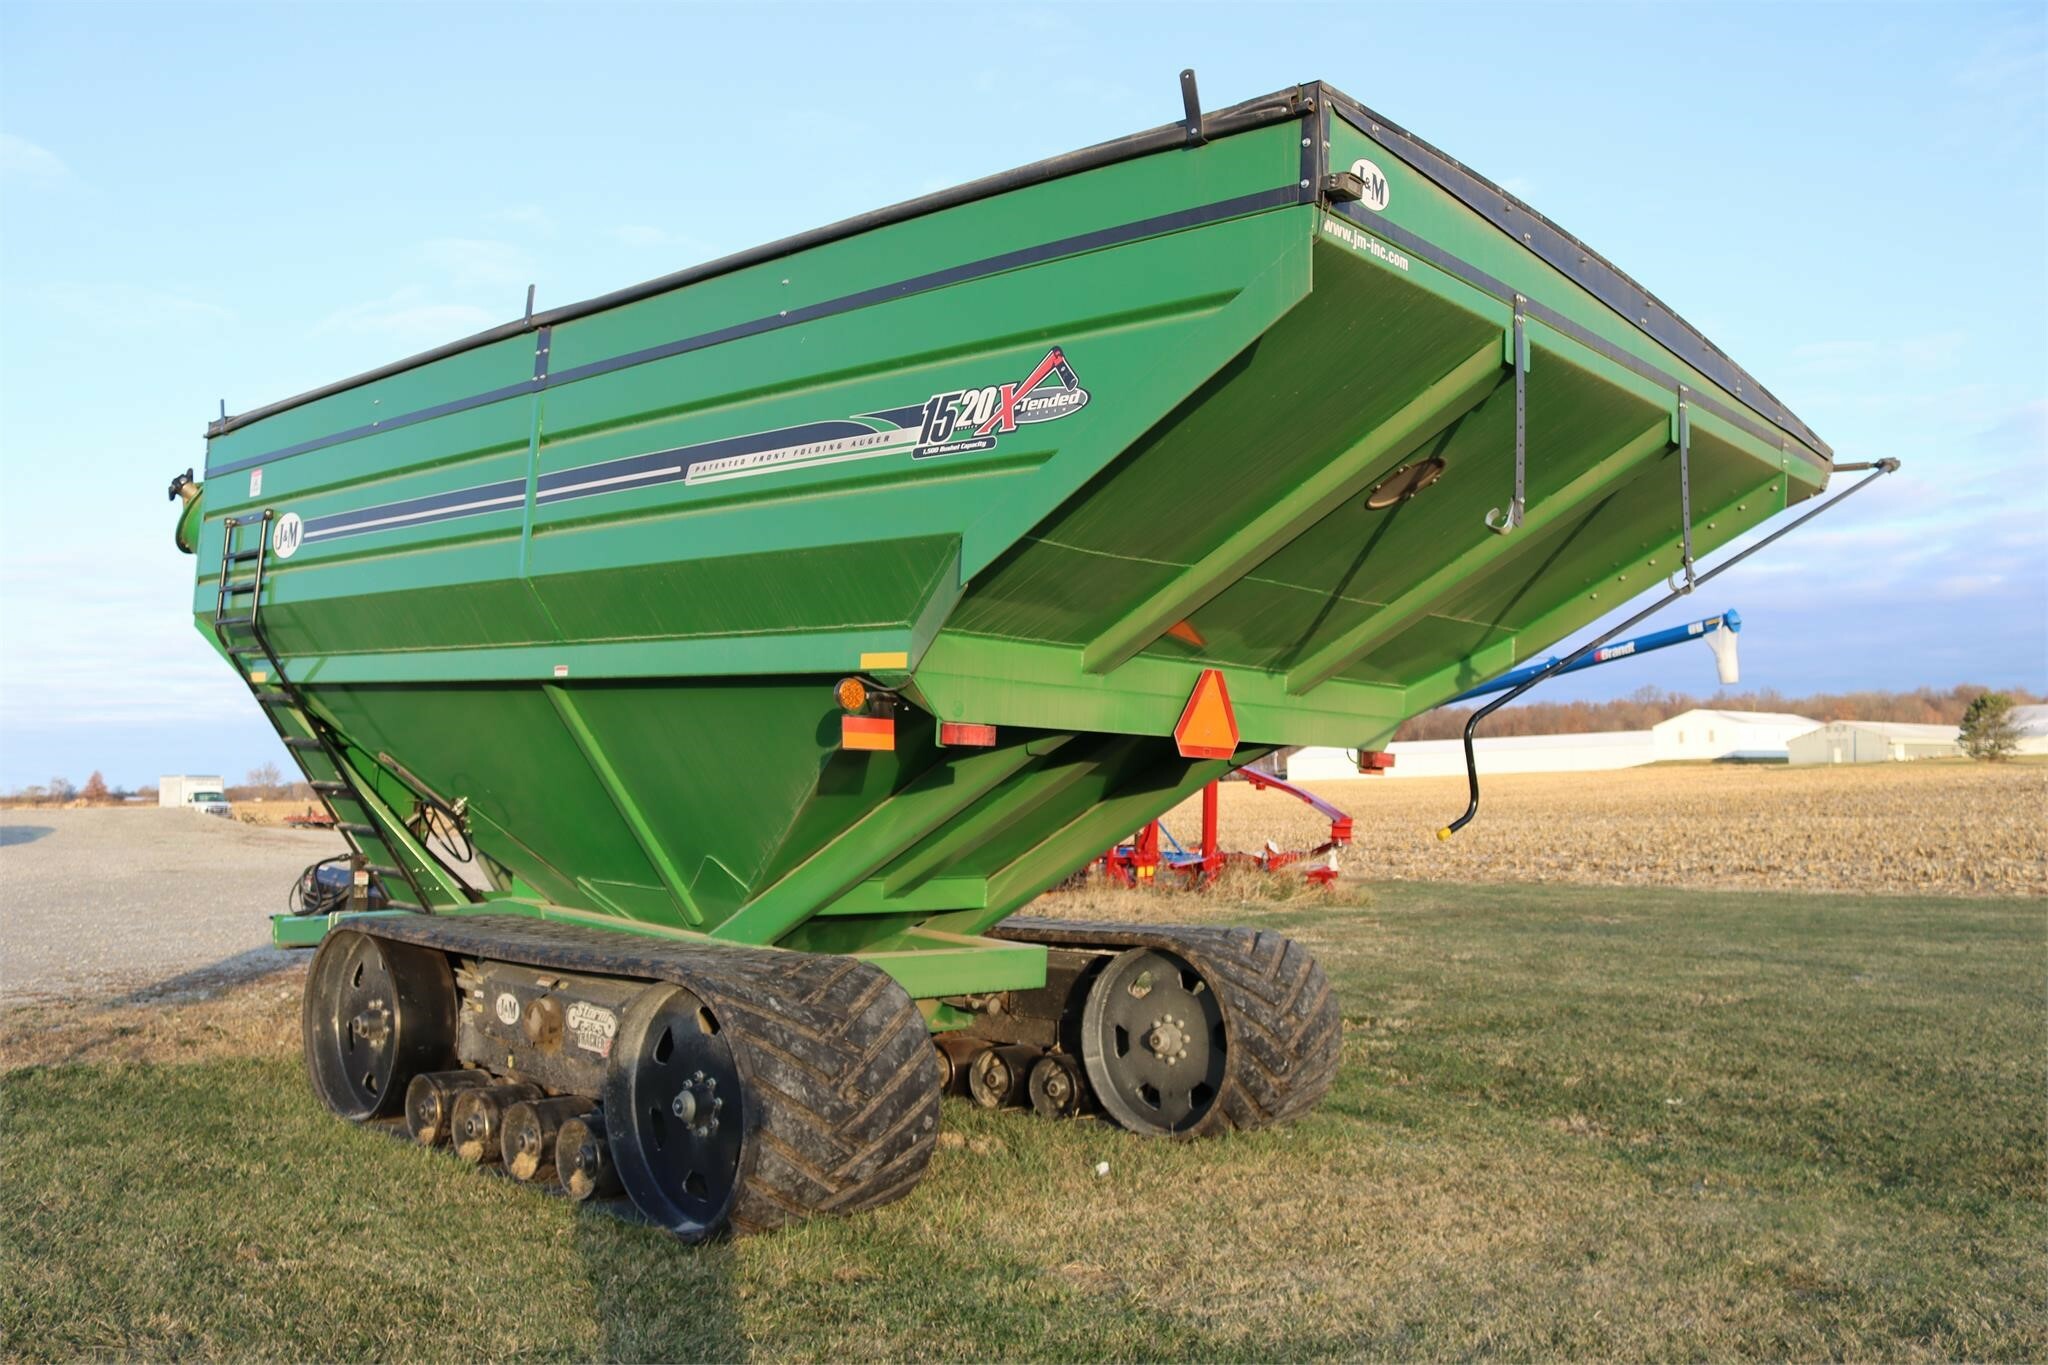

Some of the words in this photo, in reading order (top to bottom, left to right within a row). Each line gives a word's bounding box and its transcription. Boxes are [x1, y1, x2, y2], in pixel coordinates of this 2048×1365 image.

[1324, 219, 1409, 272] www.jm-inc.com
[917, 386, 997, 446] 1520
[974, 372, 1081, 437] X-Tended
[694, 457, 746, 472] PATENTED
[752, 451, 786, 462] FRONT
[793, 441, 842, 457] FOLDING
[850, 434, 890, 447] AUGER
[960, 440, 987, 450] Capacity
[275, 520, 298, 550] J&M
[1601, 641, 1635, 660] Brandt
[497, 998, 517, 1019] J&M
